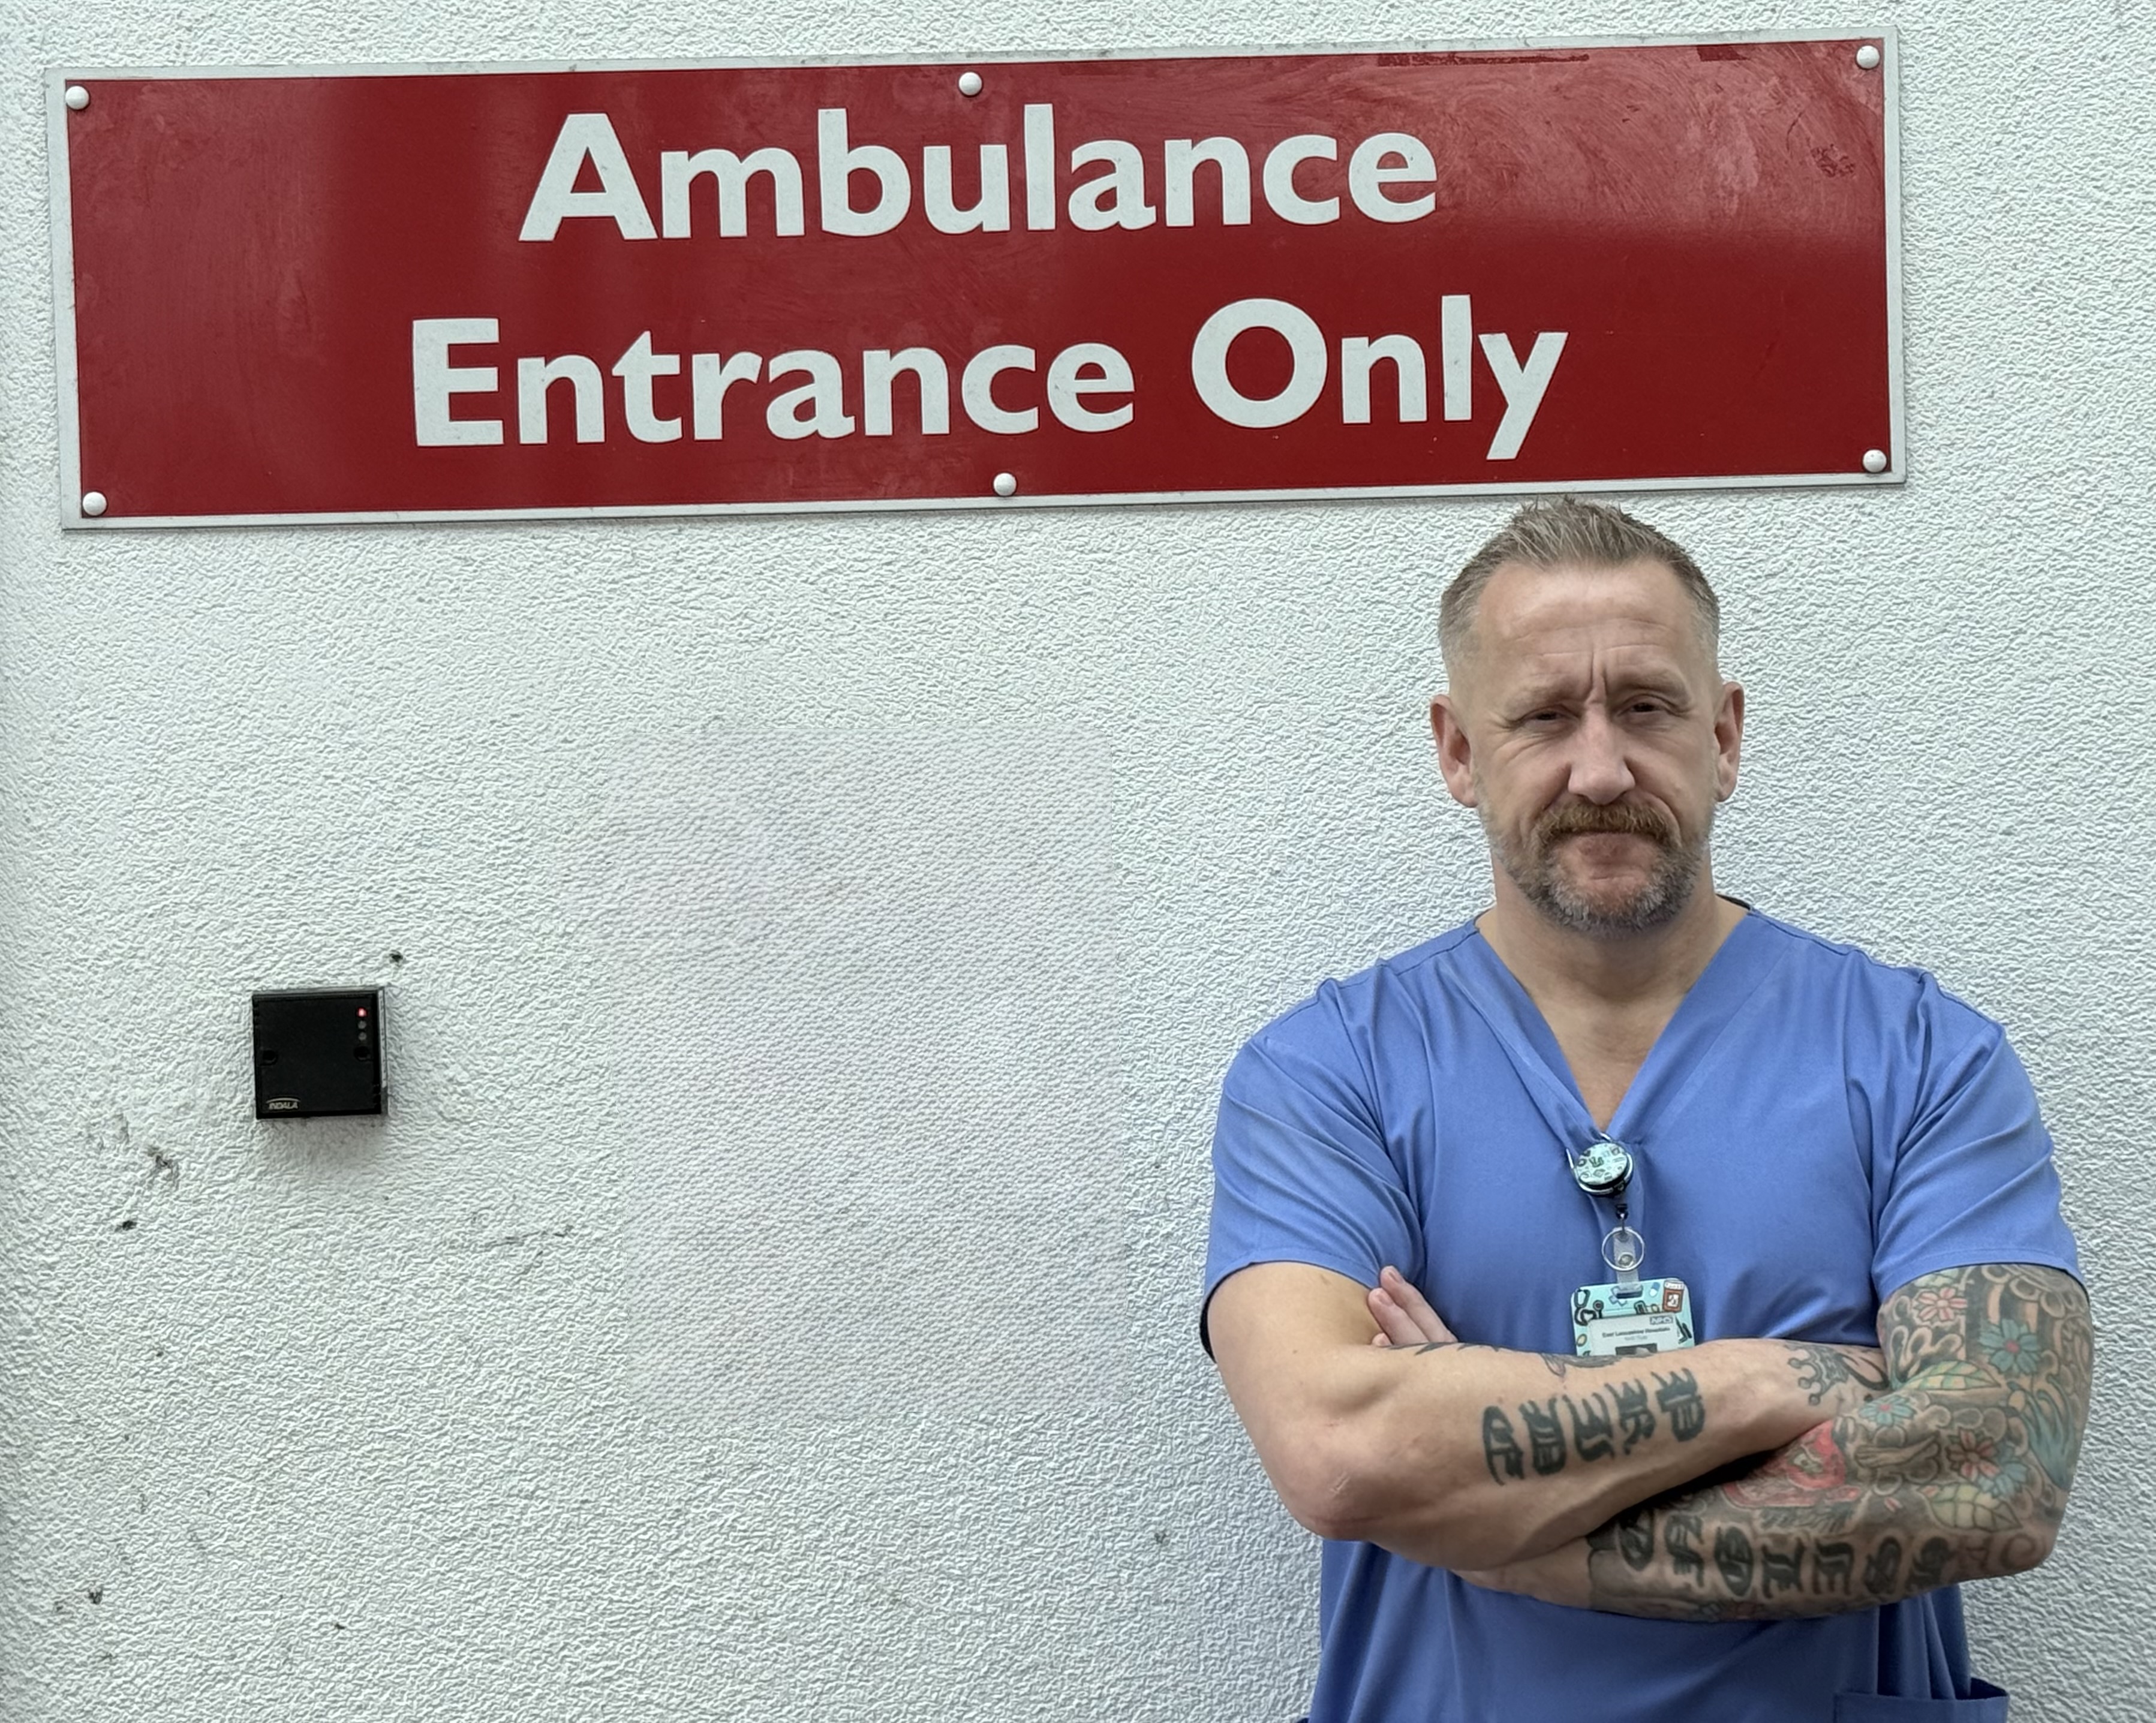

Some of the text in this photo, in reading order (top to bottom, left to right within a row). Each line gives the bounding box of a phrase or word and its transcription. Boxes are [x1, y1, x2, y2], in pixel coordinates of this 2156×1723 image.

[519, 103, 1437, 241] Ambulance
[413, 294, 1568, 459] Entrance Only
